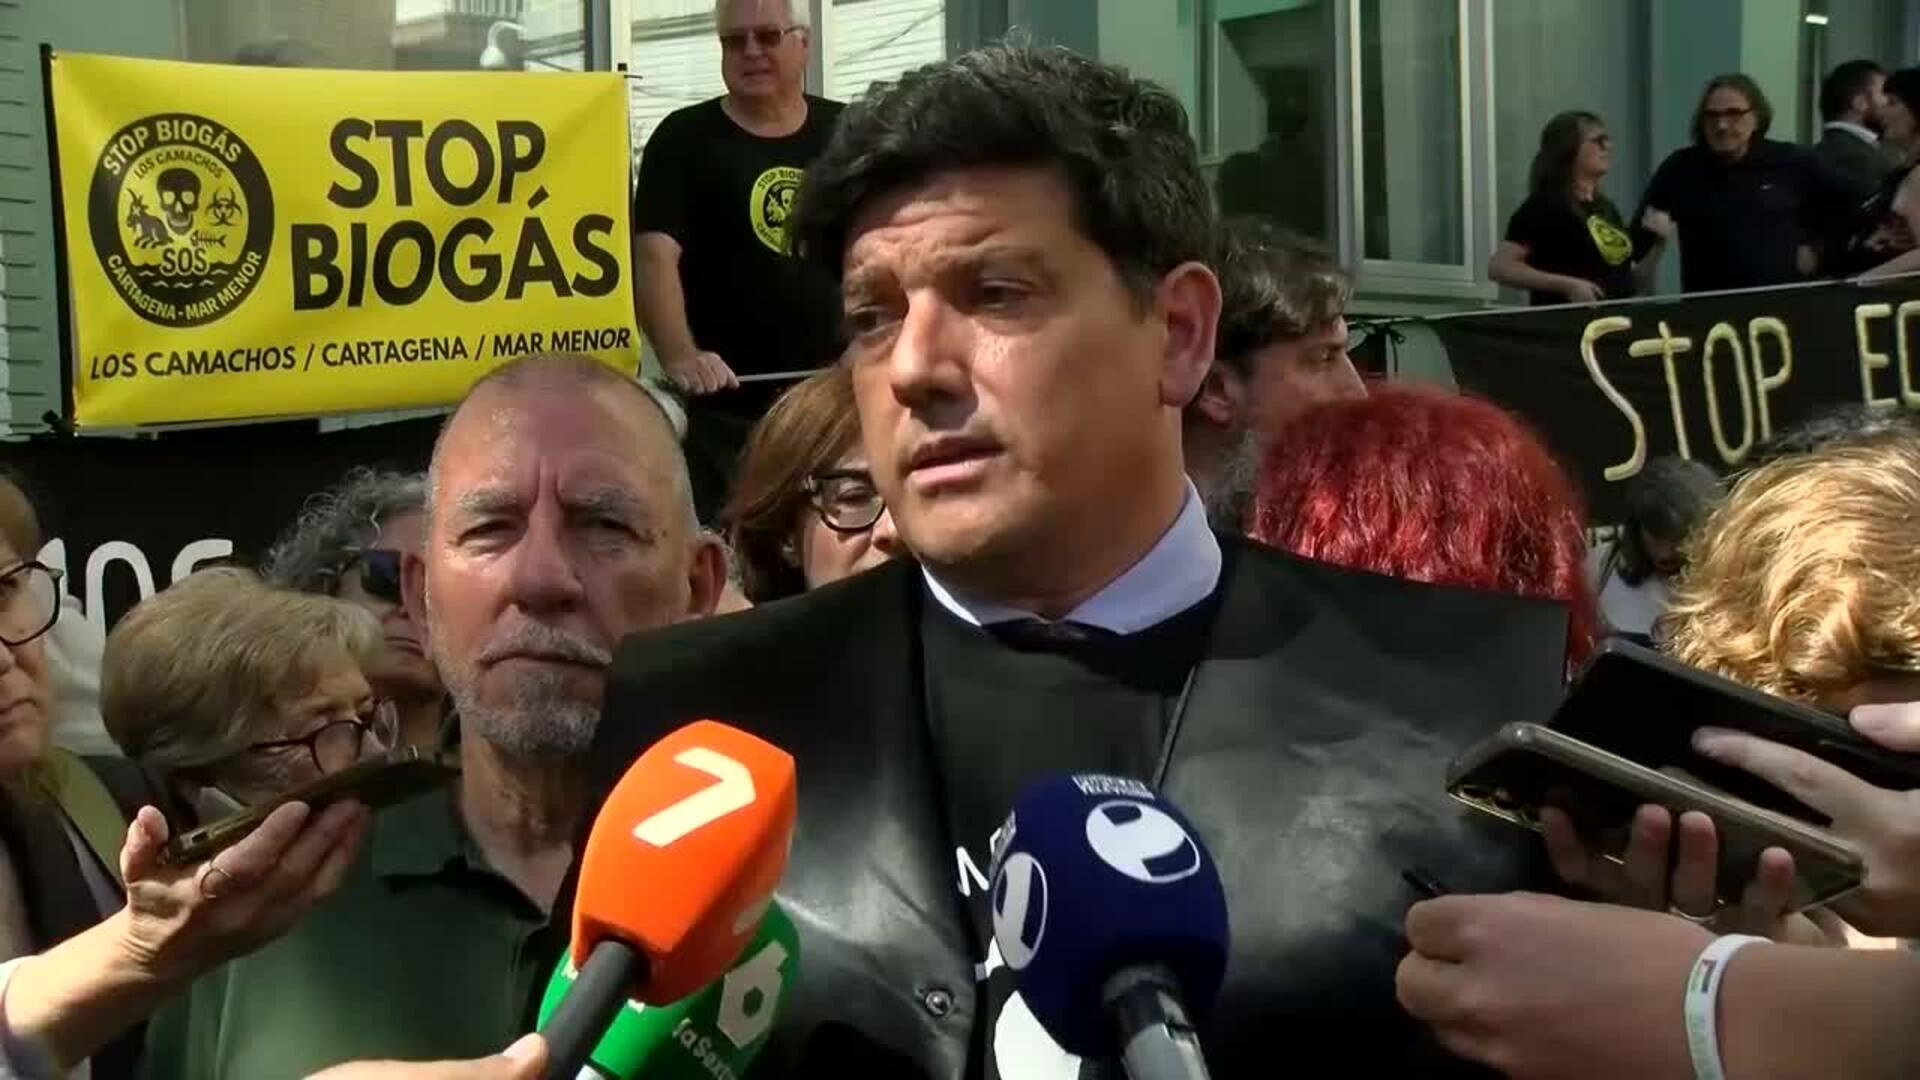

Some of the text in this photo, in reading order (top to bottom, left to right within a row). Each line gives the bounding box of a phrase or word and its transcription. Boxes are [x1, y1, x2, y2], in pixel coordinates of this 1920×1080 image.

[103, 119, 241, 175] STOP BIOGÁS
[134, 150, 224, 180] LOS CAMACHOS
[327, 118, 547, 209] STOP
[160, 247, 210, 276] SOS
[291, 185, 621, 312] BIOGÁS
[108, 254, 176, 320] CARTAGENA
[186, 297, 220, 320] MAR
[216, 251, 263, 307] MENOR
[91, 353, 137, 380] LOS
[145, 346, 296, 376] CAMACHOS
[322, 336, 468, 366] CARTAGENA
[492, 332, 544, 357] MAR
[551, 328, 631, 353] MENOR
[632, 746, 757, 848] 7
